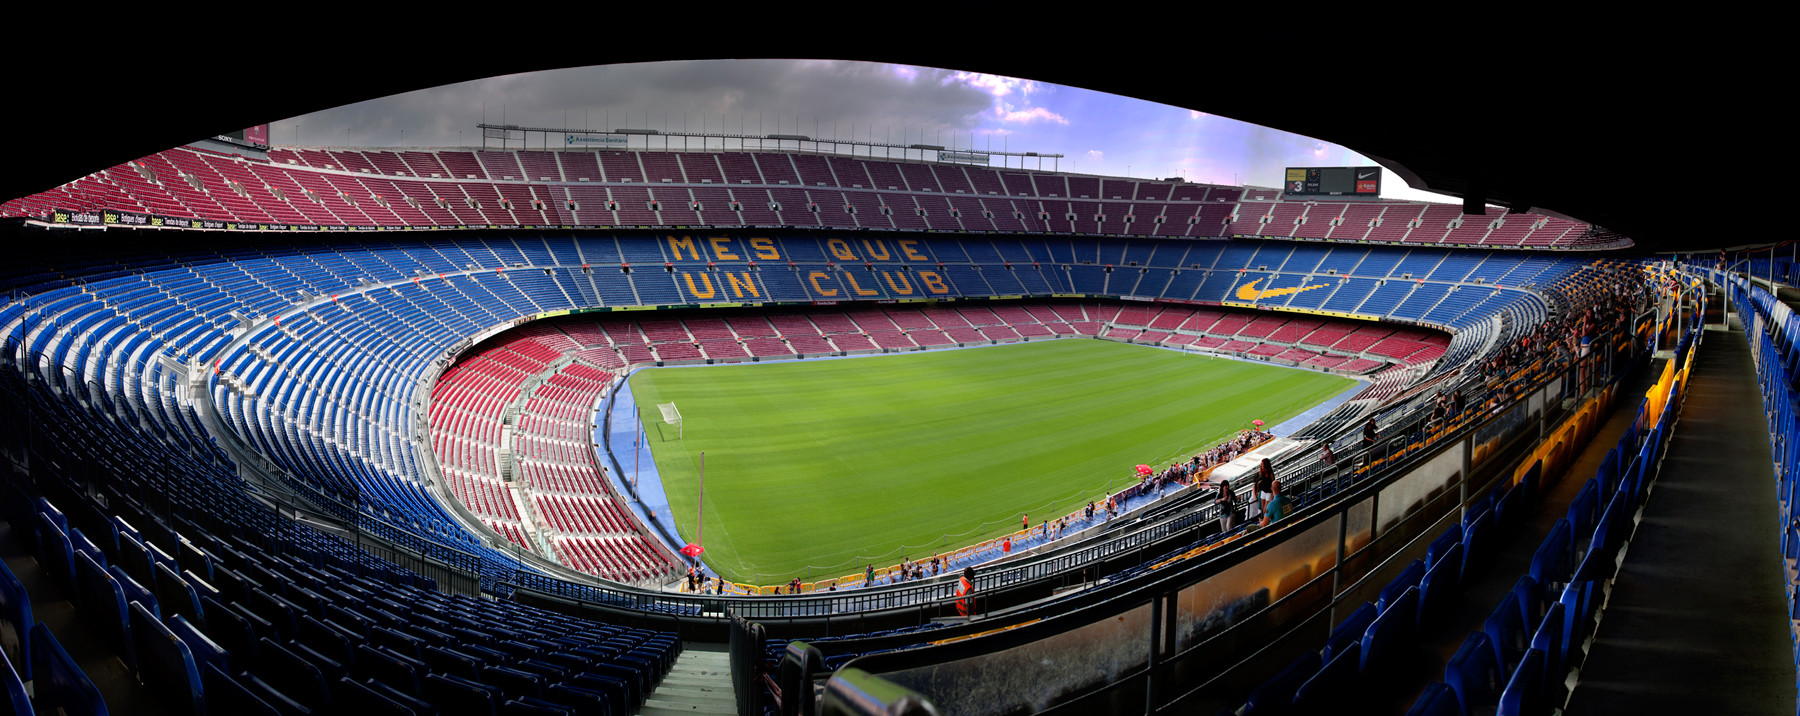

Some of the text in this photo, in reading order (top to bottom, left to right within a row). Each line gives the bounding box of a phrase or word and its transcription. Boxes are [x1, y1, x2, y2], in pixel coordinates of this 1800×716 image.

[1294, 181, 1303, 192] 3
[827, 238, 929, 261] QUE
[683, 271, 950, 299] UN CLUB
